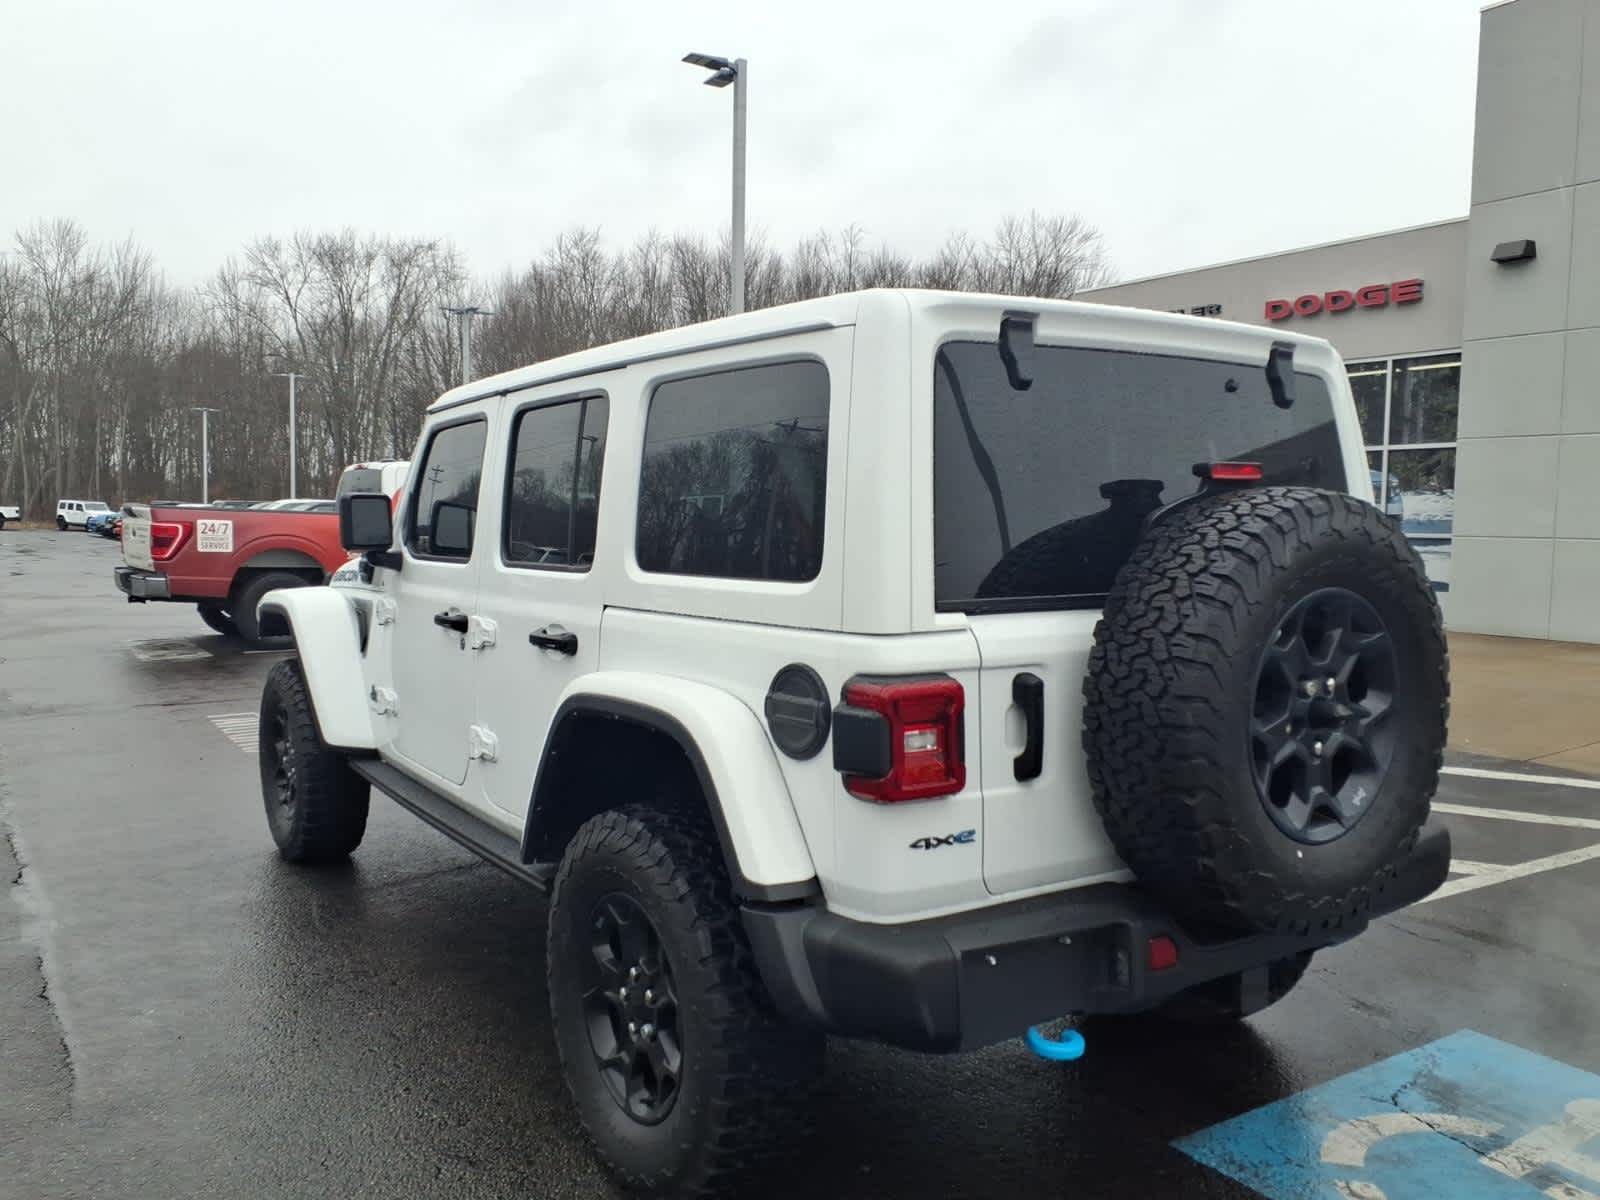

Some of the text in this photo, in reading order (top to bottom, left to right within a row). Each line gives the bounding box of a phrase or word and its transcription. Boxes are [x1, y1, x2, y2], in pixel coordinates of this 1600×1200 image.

[1264, 279, 1424, 321] DODGE
[200, 522, 229, 535] 24/7
[200, 541, 230, 550] SERVICE
